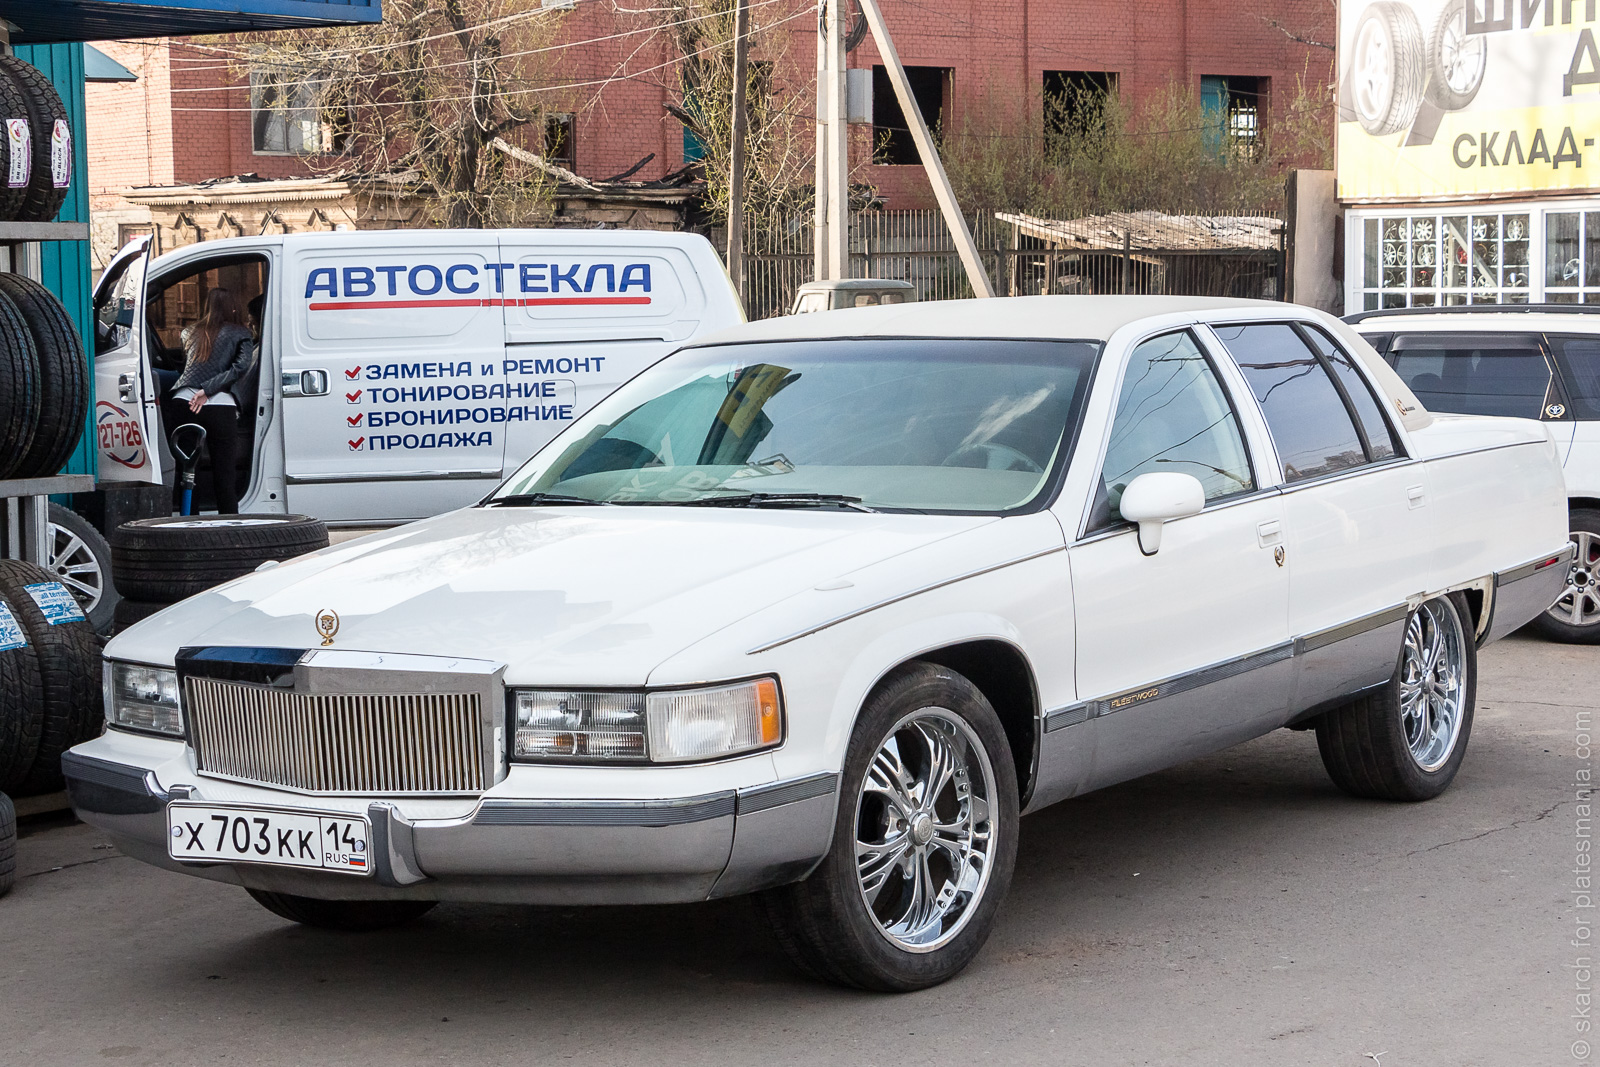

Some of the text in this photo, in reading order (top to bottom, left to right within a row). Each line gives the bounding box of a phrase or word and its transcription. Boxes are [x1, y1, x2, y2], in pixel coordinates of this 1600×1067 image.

[305, 263, 651, 298] АВТОСТЕКЛА
[366, 361, 472, 379] ЗАМЕНА
[503, 357, 606, 375] РЕМОНТ
[367, 382, 556, 403] ТОНИРОВАНИЕ
[368, 404, 573, 427] БРОНИРОВАНИЕ
[369, 431, 493, 450] ПРОДАЖА
[1111, 688, 1159, 708] FLEETWOOD
[326, 822, 357, 852] 14
[326, 852, 349, 864] RUS
